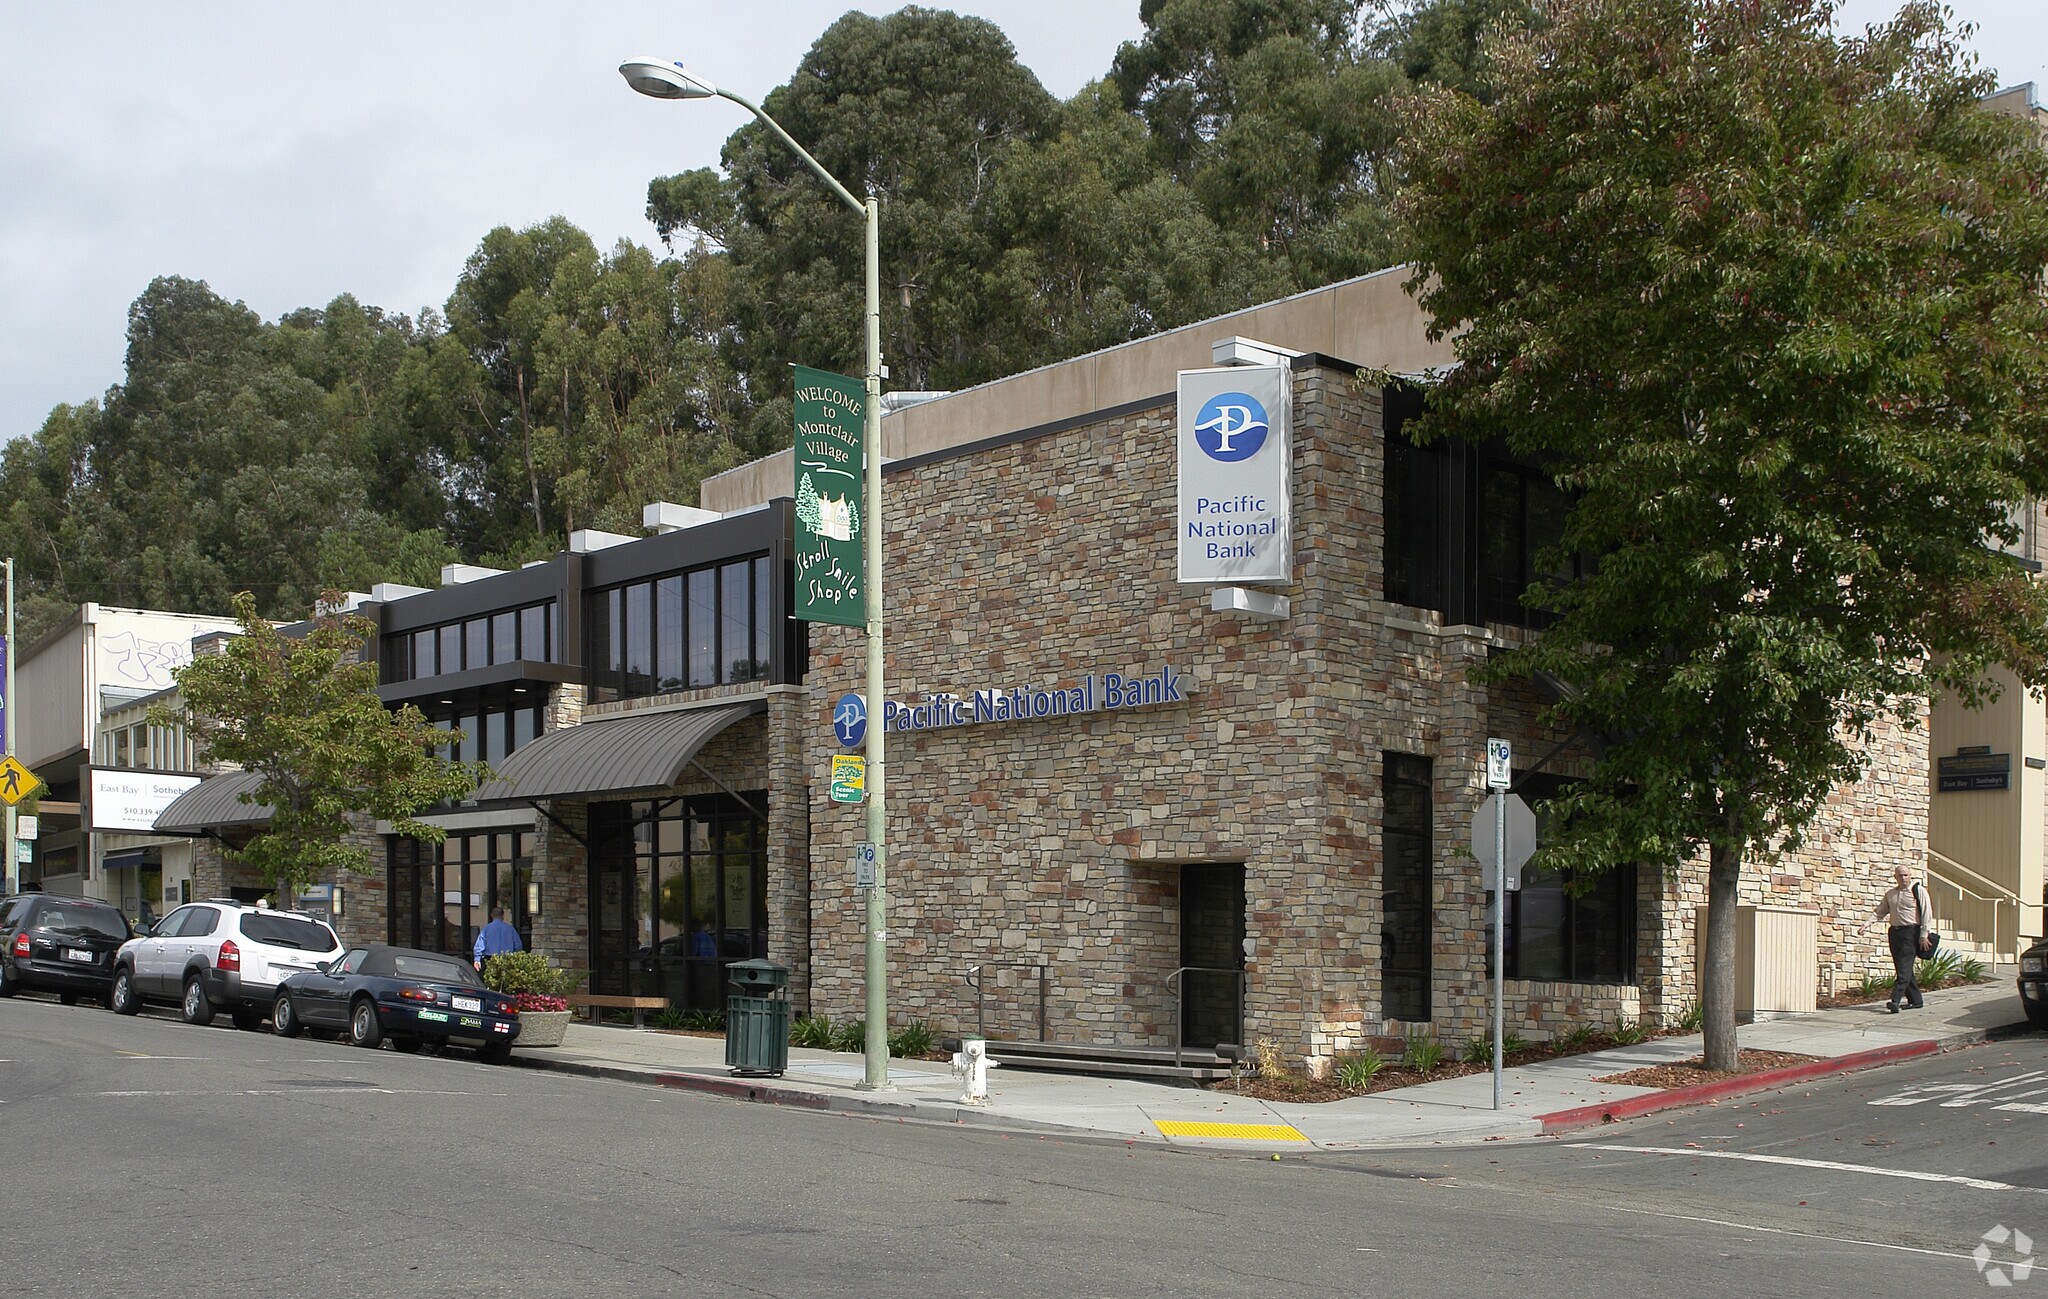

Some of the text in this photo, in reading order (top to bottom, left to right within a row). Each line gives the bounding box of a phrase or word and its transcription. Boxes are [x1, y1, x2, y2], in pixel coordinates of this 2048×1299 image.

[796, 386, 862, 416] WELCOME
[823, 405, 836, 419] to
[797, 421, 859, 448] Montclair
[806, 441, 849, 463] Village
[1197, 495, 1266, 514] Pacific
[1188, 518, 1276, 538] National
[796, 540, 830, 581] Stroll
[1206, 541, 1256, 559] Bank
[825, 557, 858, 599] Smile
[807, 579, 842, 606] Shop
[884, 664, 1182, 732] Pacific National Bank
[100, 783, 119, 793] East
[122, 784, 139, 797] Bay
